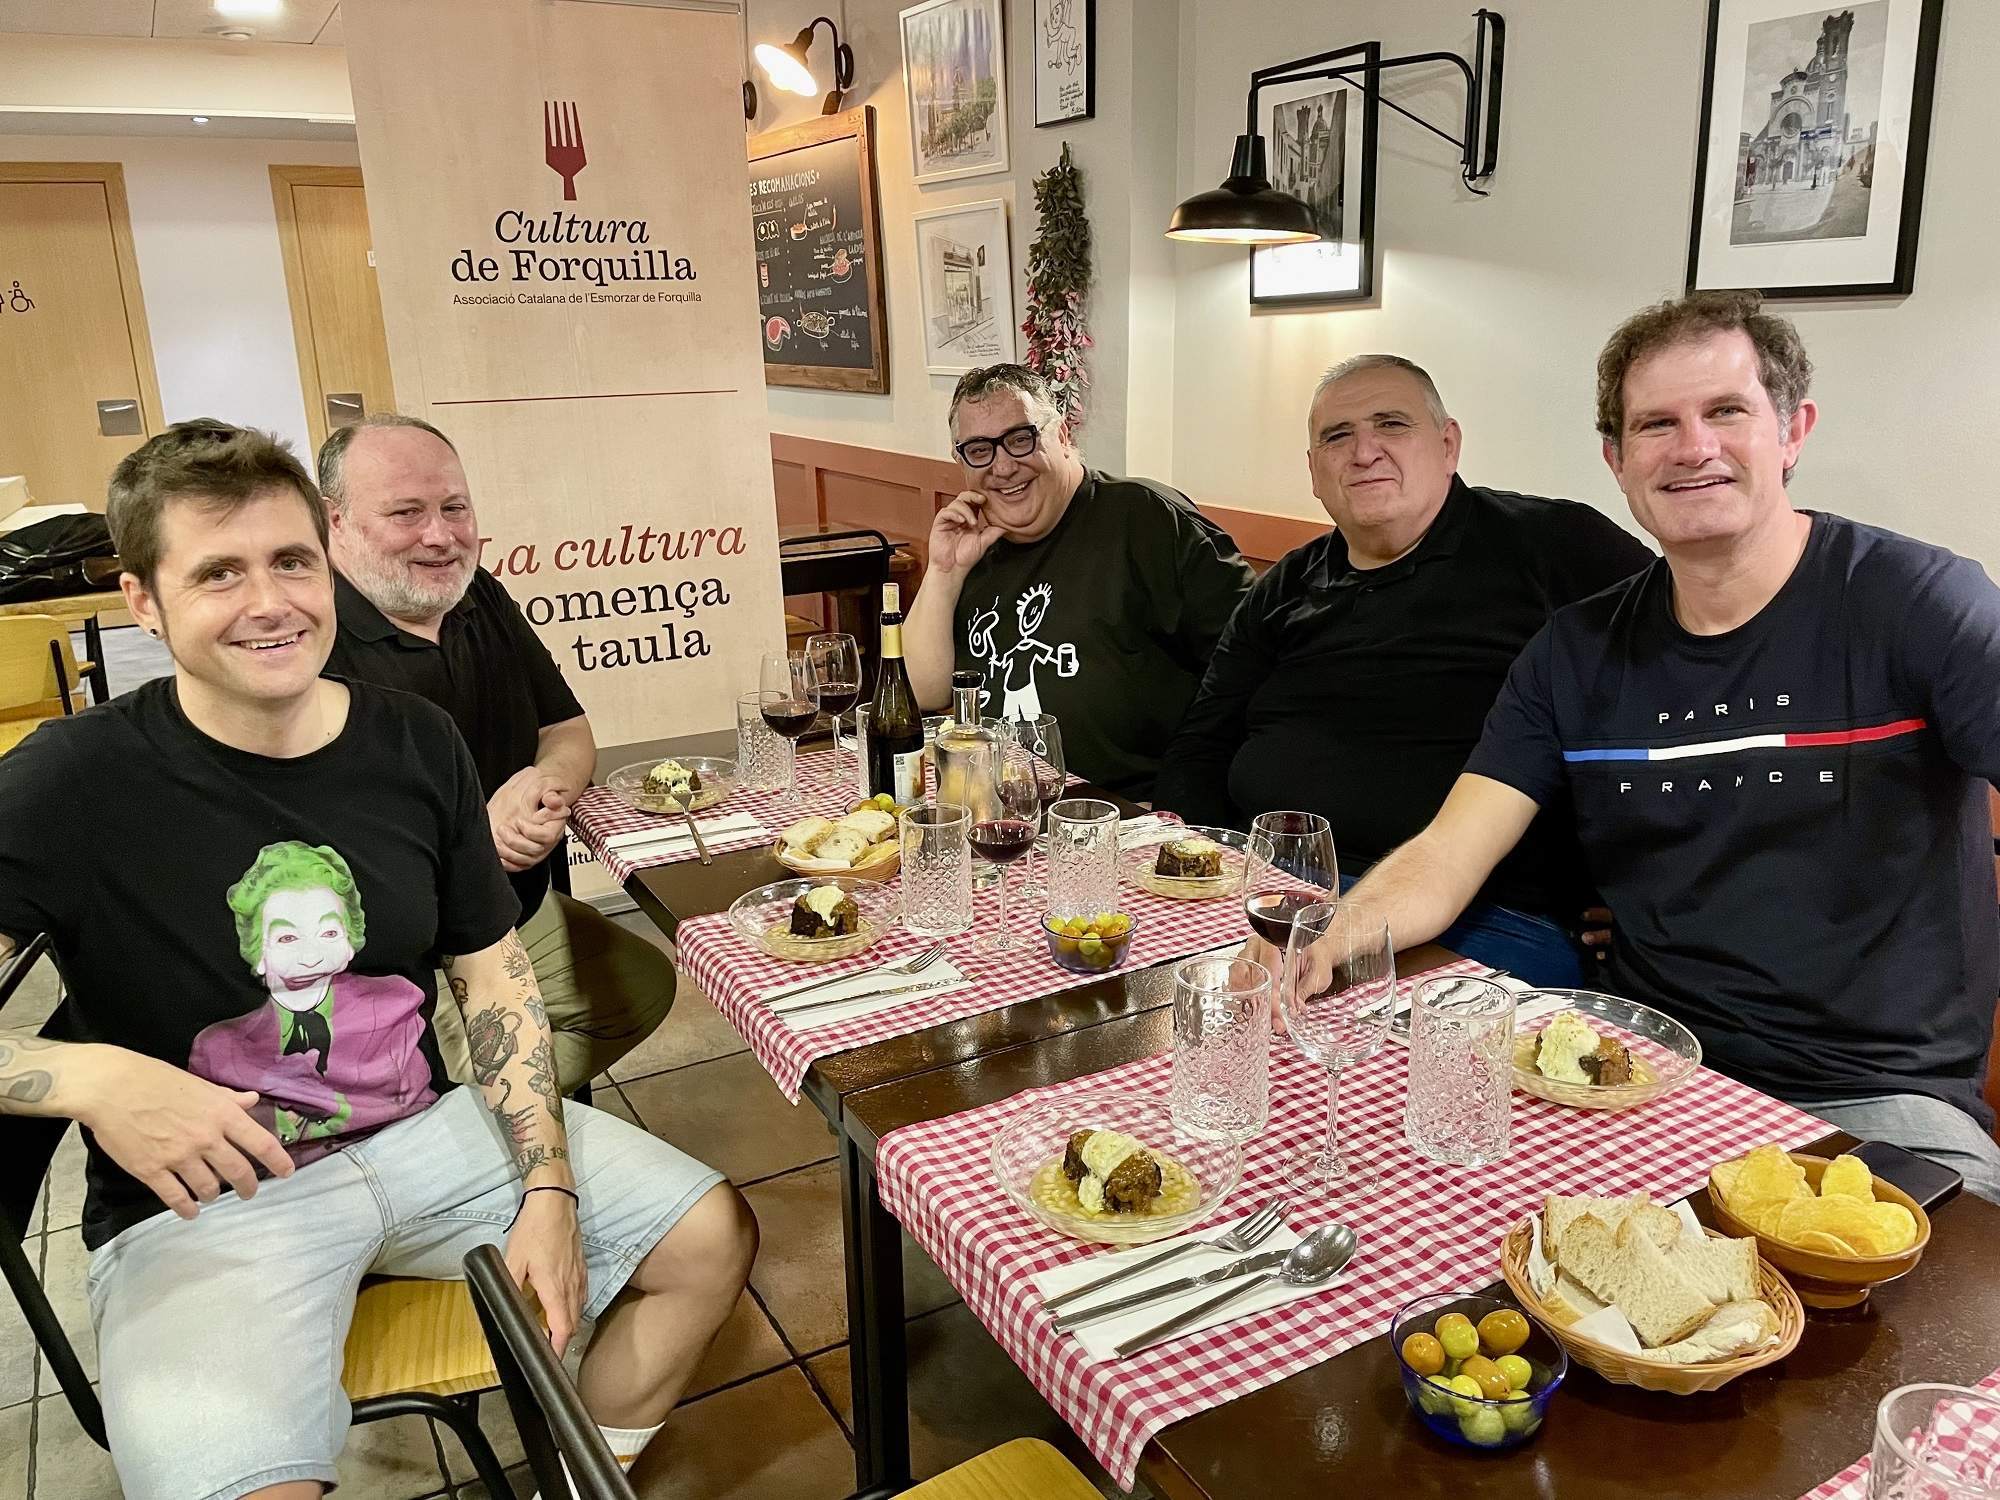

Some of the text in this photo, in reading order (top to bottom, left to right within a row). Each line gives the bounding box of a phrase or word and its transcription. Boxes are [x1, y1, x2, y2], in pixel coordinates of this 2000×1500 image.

[495, 210, 650, 244] Cultura
[451, 249, 697, 287] de Forquilla
[453, 291, 702, 305] Associació Catalana de l'Esmorzar de Forquilla
[554, 524, 747, 571] cultura
[525, 577, 731, 626] omença
[571, 622, 711, 672] taula
[1658, 694, 1790, 724] PARIS
[1620, 771, 1834, 794] FRANCE
